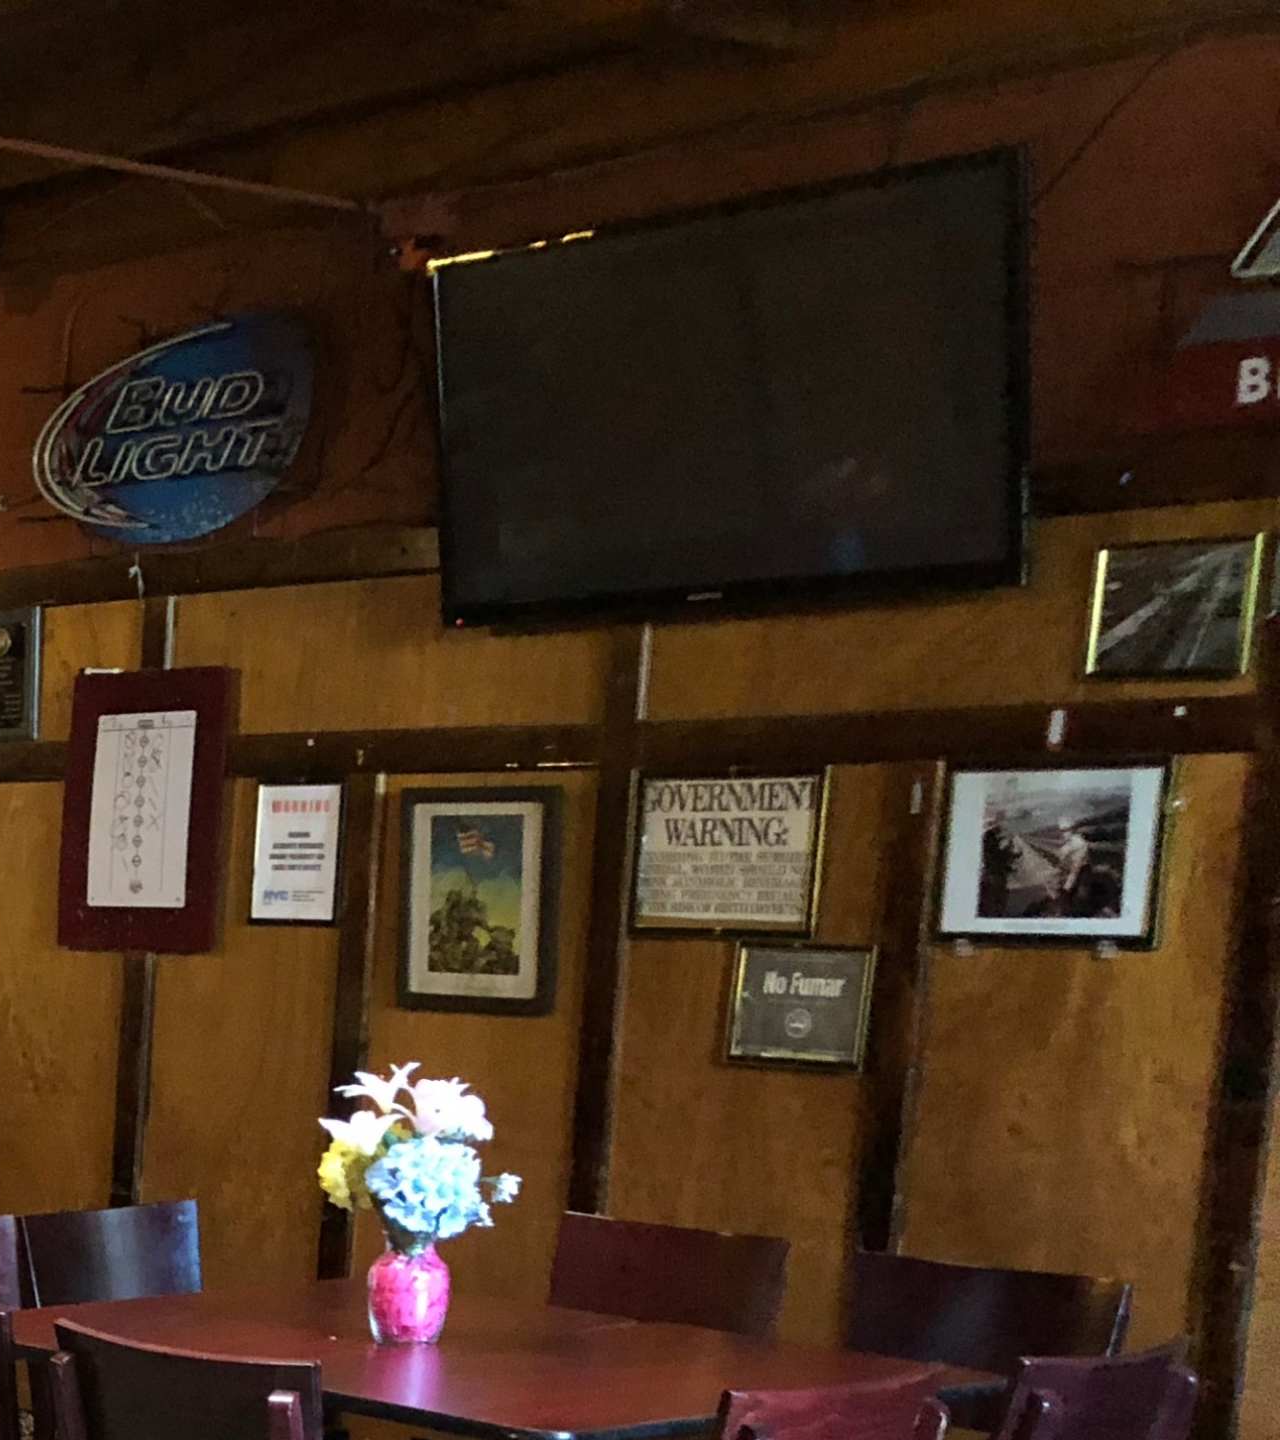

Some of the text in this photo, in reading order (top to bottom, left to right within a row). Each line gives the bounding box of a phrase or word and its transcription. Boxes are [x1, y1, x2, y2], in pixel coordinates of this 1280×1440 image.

[105, 370, 264, 434] BUD
[71, 416, 282, 487] LIGHT
[664, 816, 789, 847] WARNING:
[762, 970, 848, 998] No Fumar
